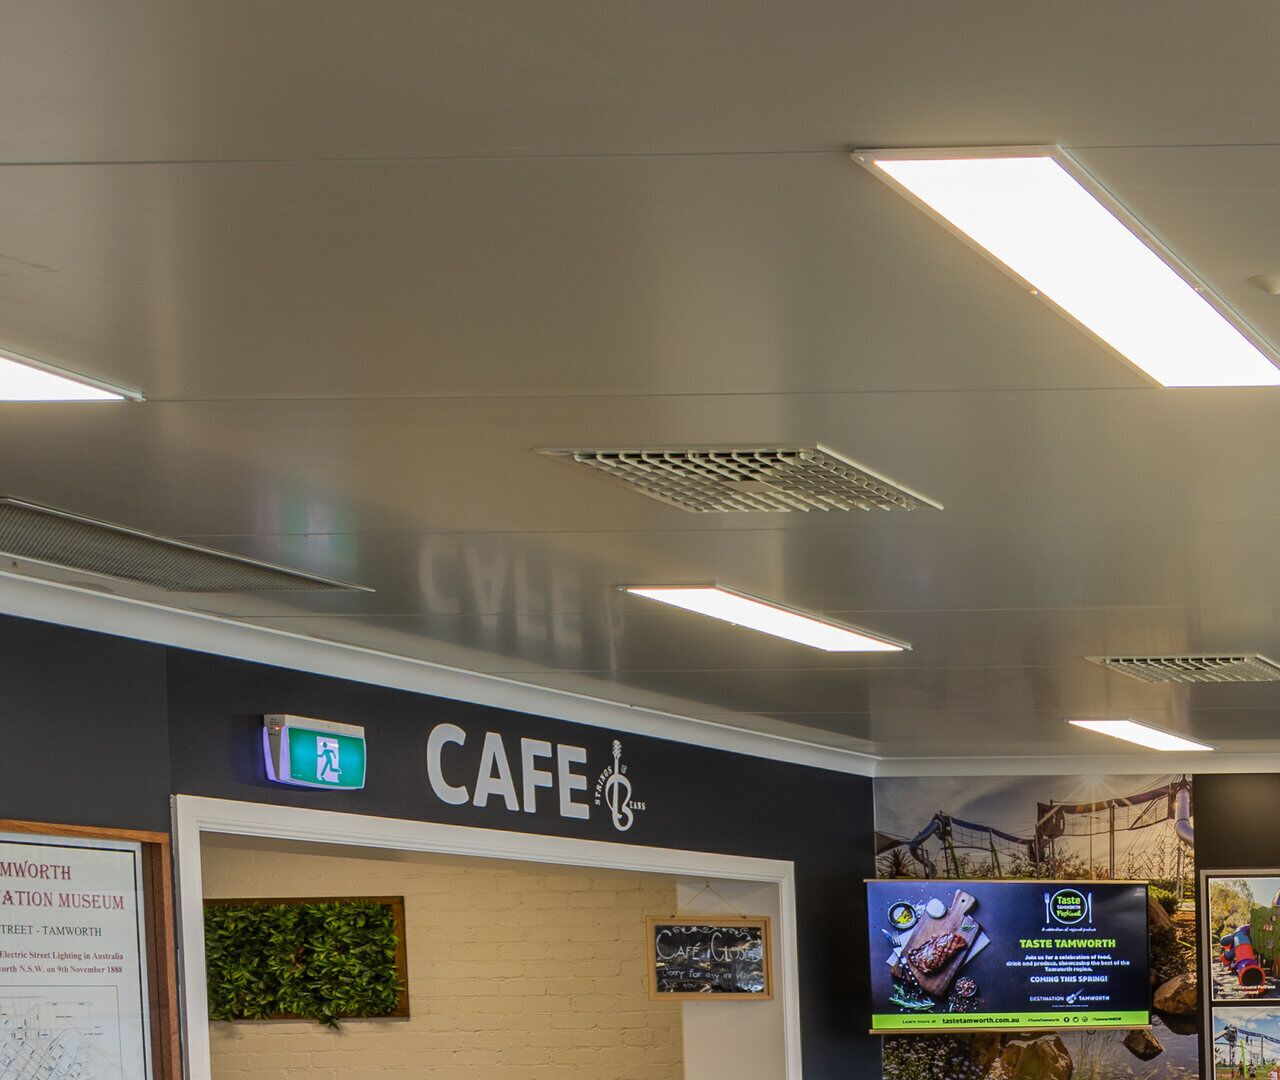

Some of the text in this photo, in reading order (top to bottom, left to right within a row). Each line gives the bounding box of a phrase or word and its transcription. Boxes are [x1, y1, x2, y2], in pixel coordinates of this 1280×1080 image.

[426, 723, 590, 820] CAFE
[0, 860, 72, 881] MWORTH
[0, 890, 125, 910] ATION MUSEUM
[1056, 896, 1081, 904] Taste
[0, 924, 102, 937] TREET TAMWORTH
[1019, 939, 1116, 948] TASTE TAMWORTH
[29, 951, 50, 959] Street
[53, 952, 82, 961] Lighting
[20, 965, 45, 973] N.S.W.
[58, 965, 69, 973] 9th
[70, 966, 105, 974] November
[107, 966, 123, 974] 1888
[942, 1016, 1020, 1025] tastetamworth.com.au
